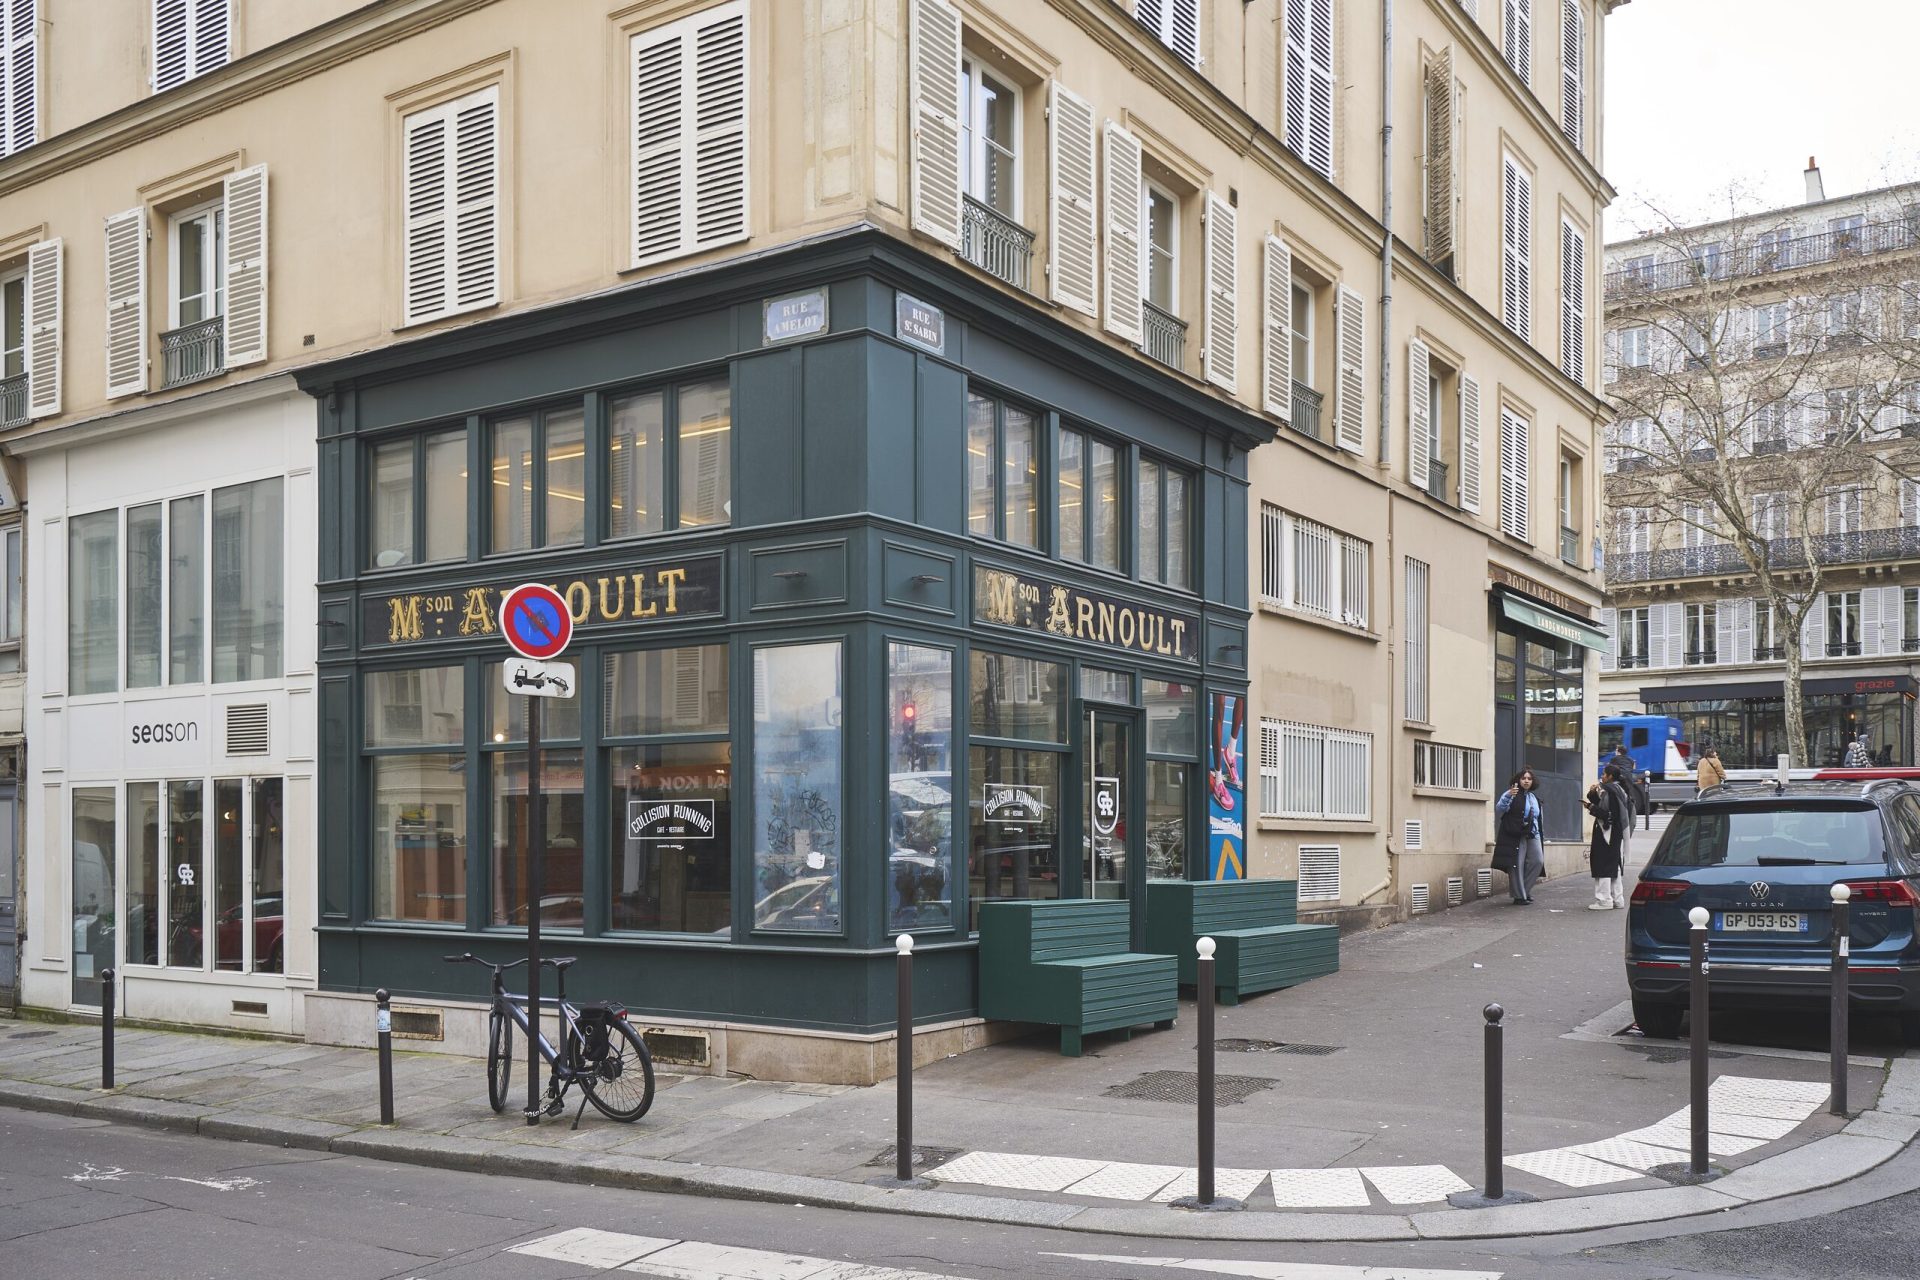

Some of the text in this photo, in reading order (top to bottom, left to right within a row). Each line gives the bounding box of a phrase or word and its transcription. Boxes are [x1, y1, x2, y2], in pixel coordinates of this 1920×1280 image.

[783, 302, 808, 317] RUE
[912, 308, 930, 324] RUE
[774, 315, 819, 334] AMELOT
[913, 324, 937, 343] SABIN
[1506, 571, 1569, 610] BOULANGERIE
[459, 568, 686, 636] AOULT
[1045, 584, 1186, 656] ARNOULT
[1855, 679, 1896, 693] grazie
[132, 721, 198, 744] season
[985, 788, 1041, 817] COLLISION RUNNING
[631, 804, 712, 834] COLLISION RUNNING
[1726, 914, 1797, 928] GP-053-GS
